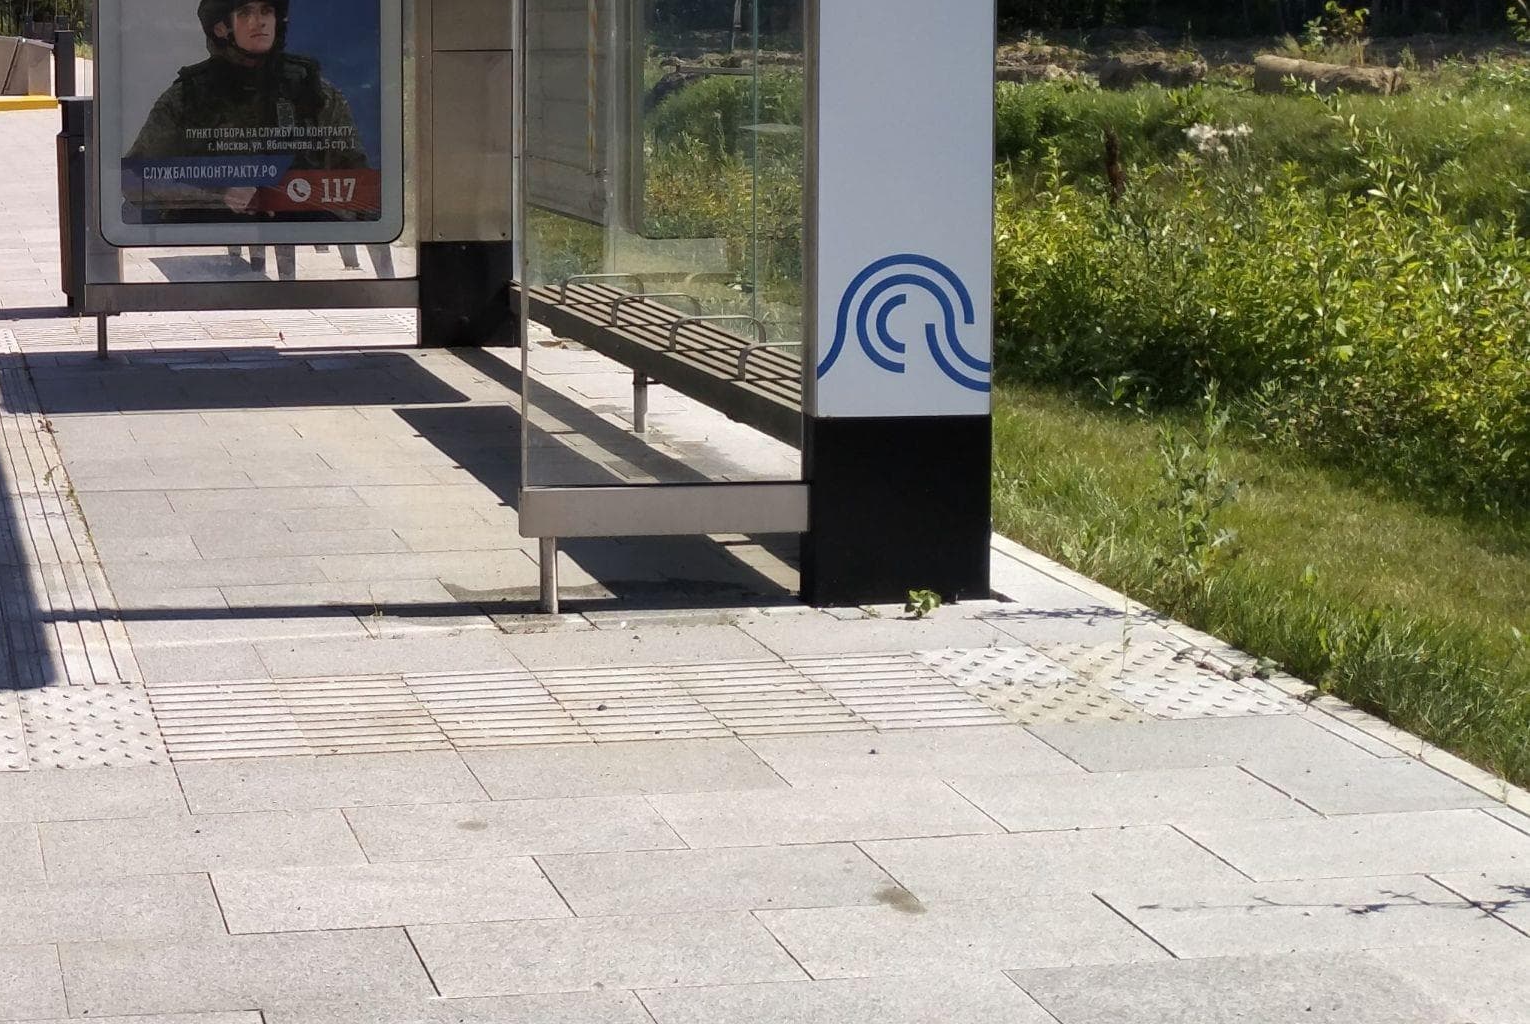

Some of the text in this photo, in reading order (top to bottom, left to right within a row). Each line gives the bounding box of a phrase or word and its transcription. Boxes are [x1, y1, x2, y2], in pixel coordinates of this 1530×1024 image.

[186, 128, 212, 139] ПУНКТ
[213, 128, 245, 138] ОТБОРА
[246, 128, 257, 138] НА
[258, 127, 292, 138] СЛУЖБУ
[293, 126, 305, 137] ПО
[216, 141, 251, 152] Москва,
[143, 165, 278, 180] СЛУЖБАПОКОНТРАКТУ.РФ
[321, 178, 357, 203] 117
